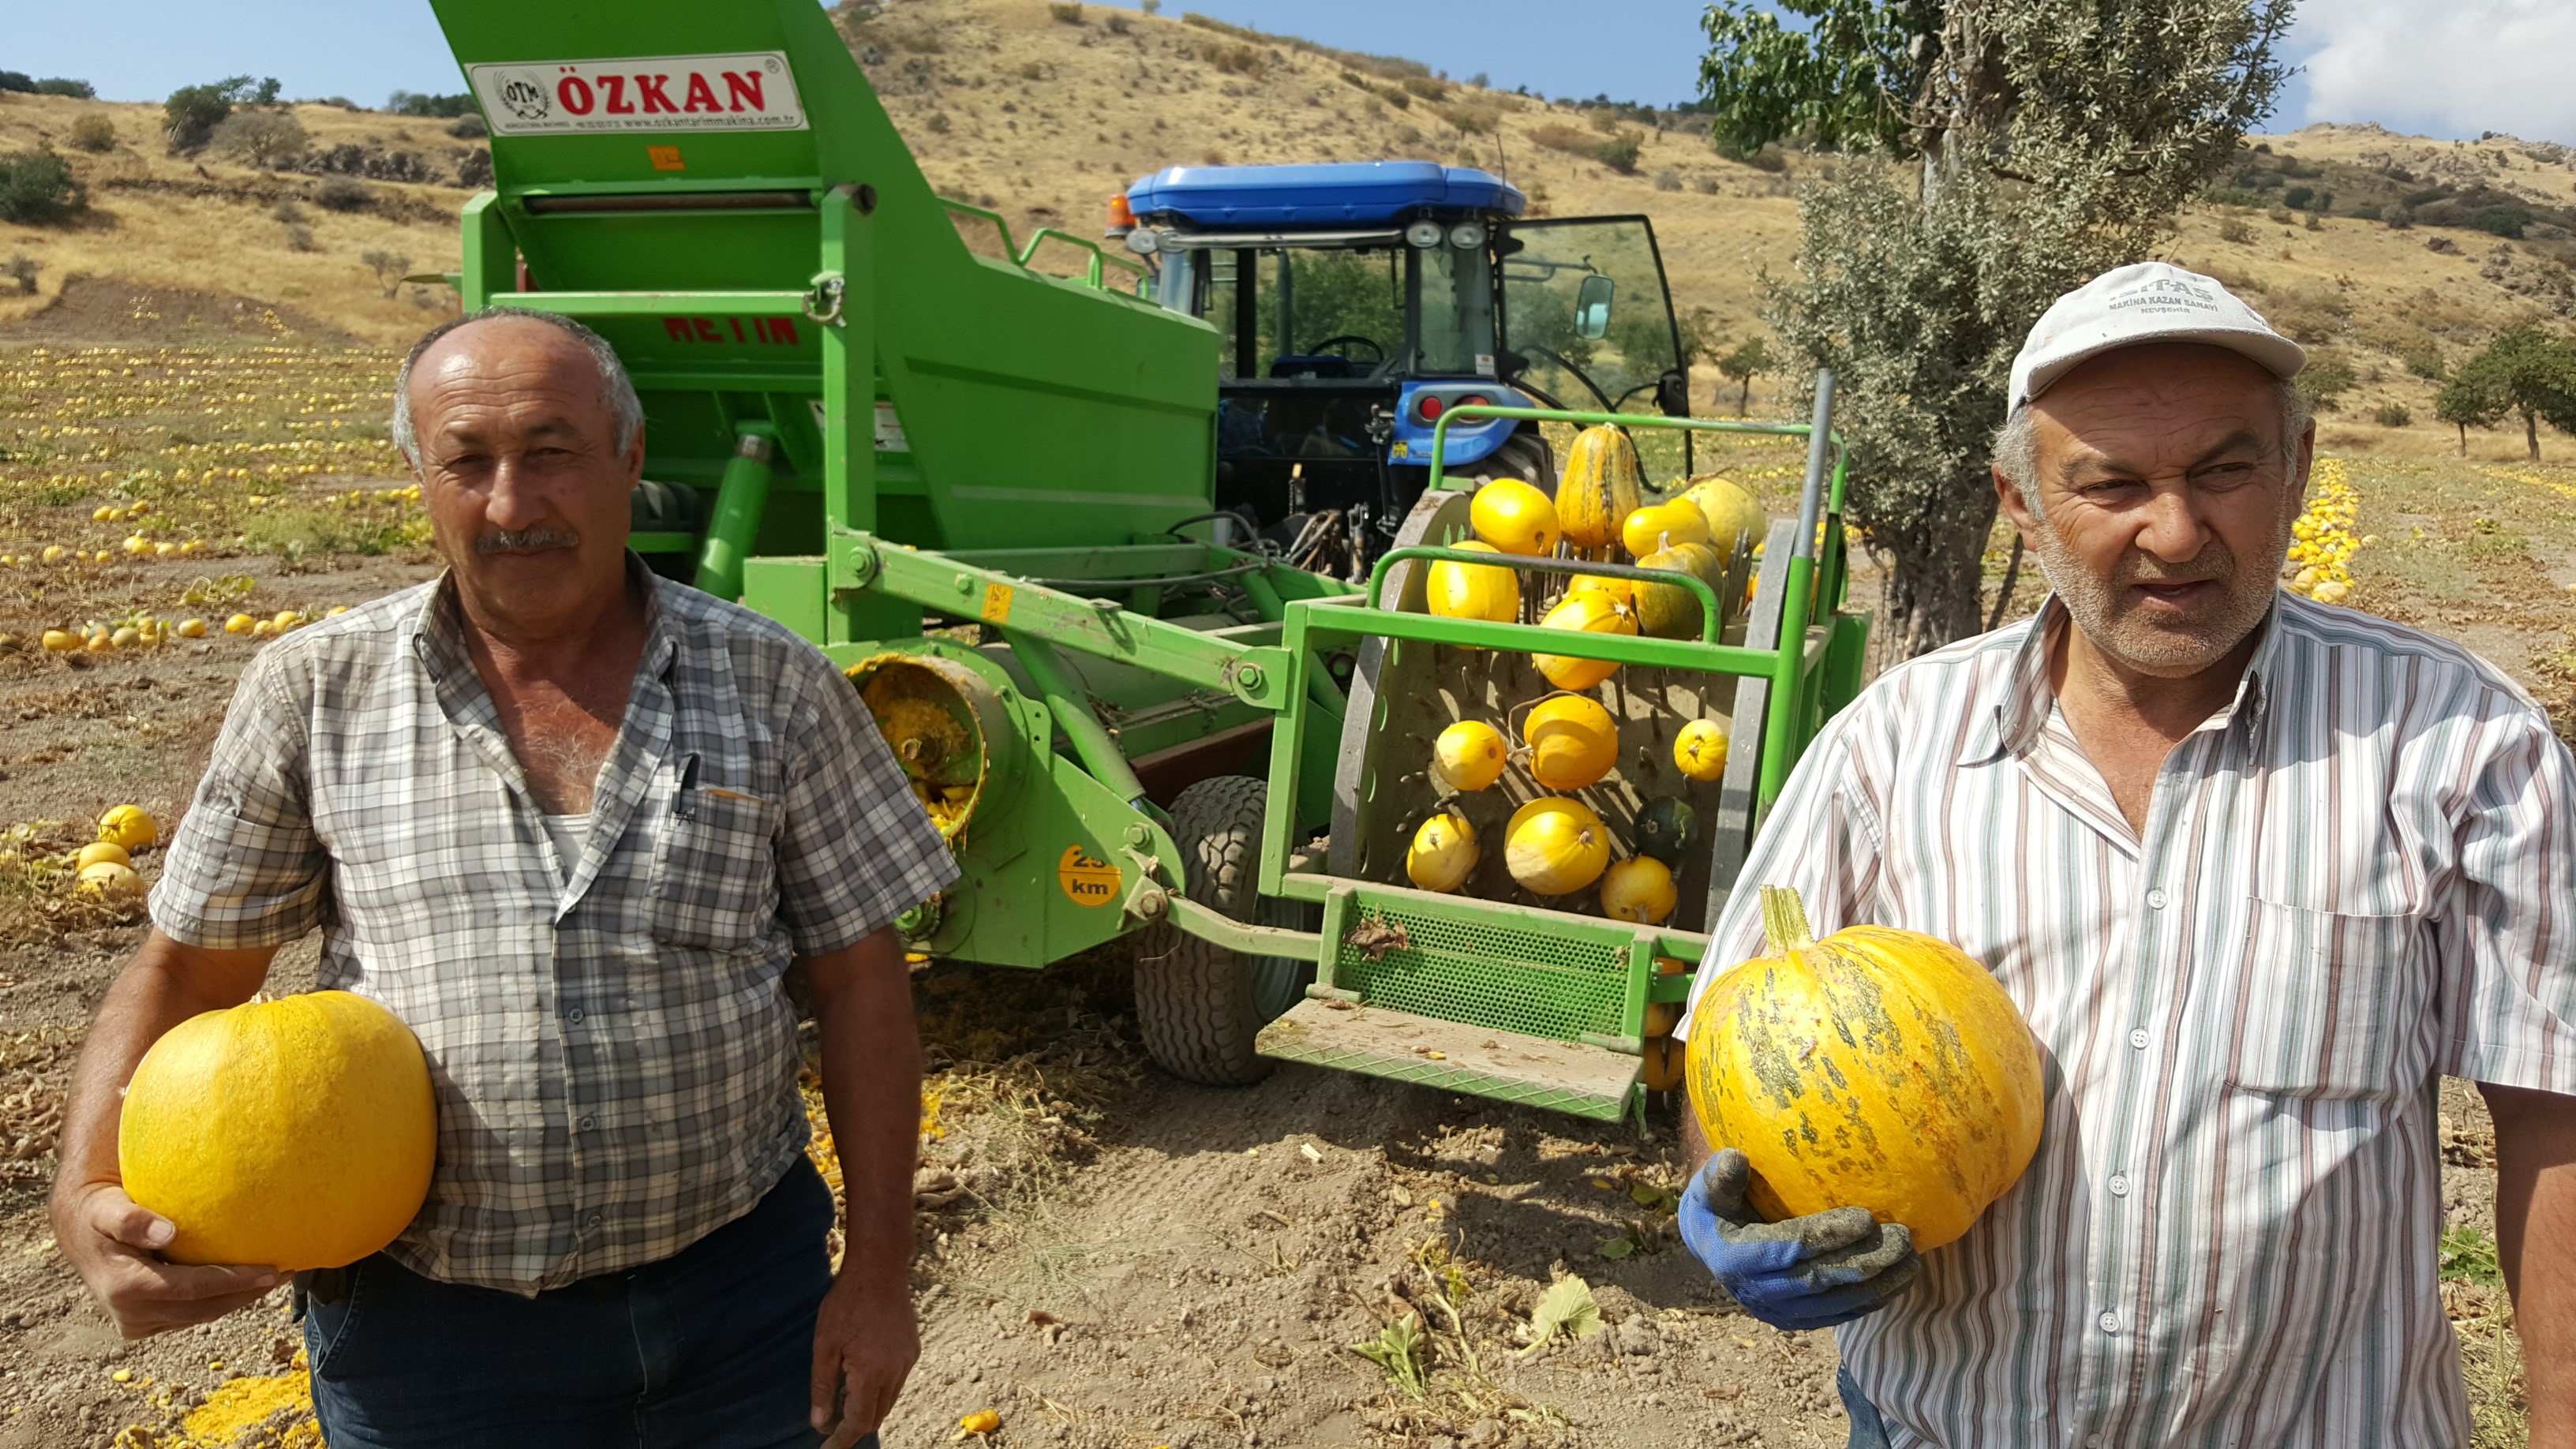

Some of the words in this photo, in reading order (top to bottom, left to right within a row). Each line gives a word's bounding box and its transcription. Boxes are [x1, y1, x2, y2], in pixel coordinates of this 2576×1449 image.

[557, 66, 766, 115] ÖZKAN
[2148, 296, 2181, 305] KAZAN
[1072, 878, 1109, 895] km
